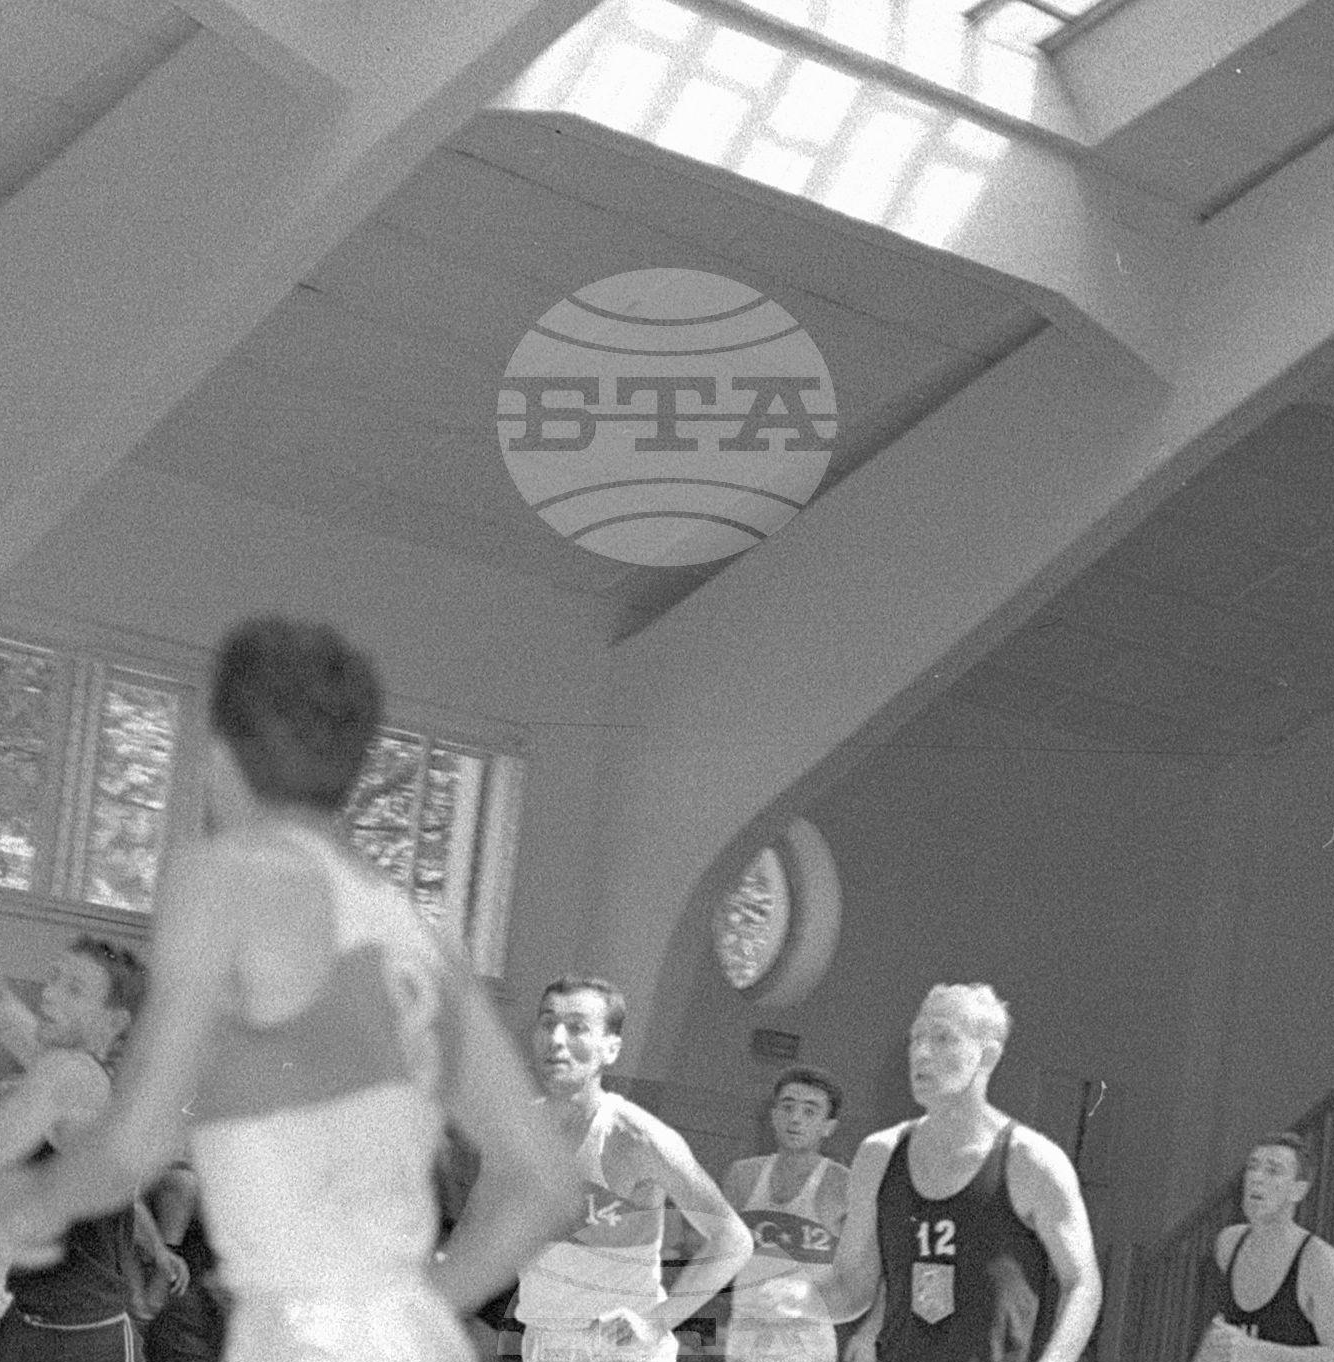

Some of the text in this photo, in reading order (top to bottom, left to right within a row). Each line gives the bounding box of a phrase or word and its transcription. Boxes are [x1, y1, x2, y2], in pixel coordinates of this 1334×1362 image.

[585, 1193, 624, 1227] 14
[801, 1225, 832, 1252] 12
[917, 1219, 957, 1256] 12
